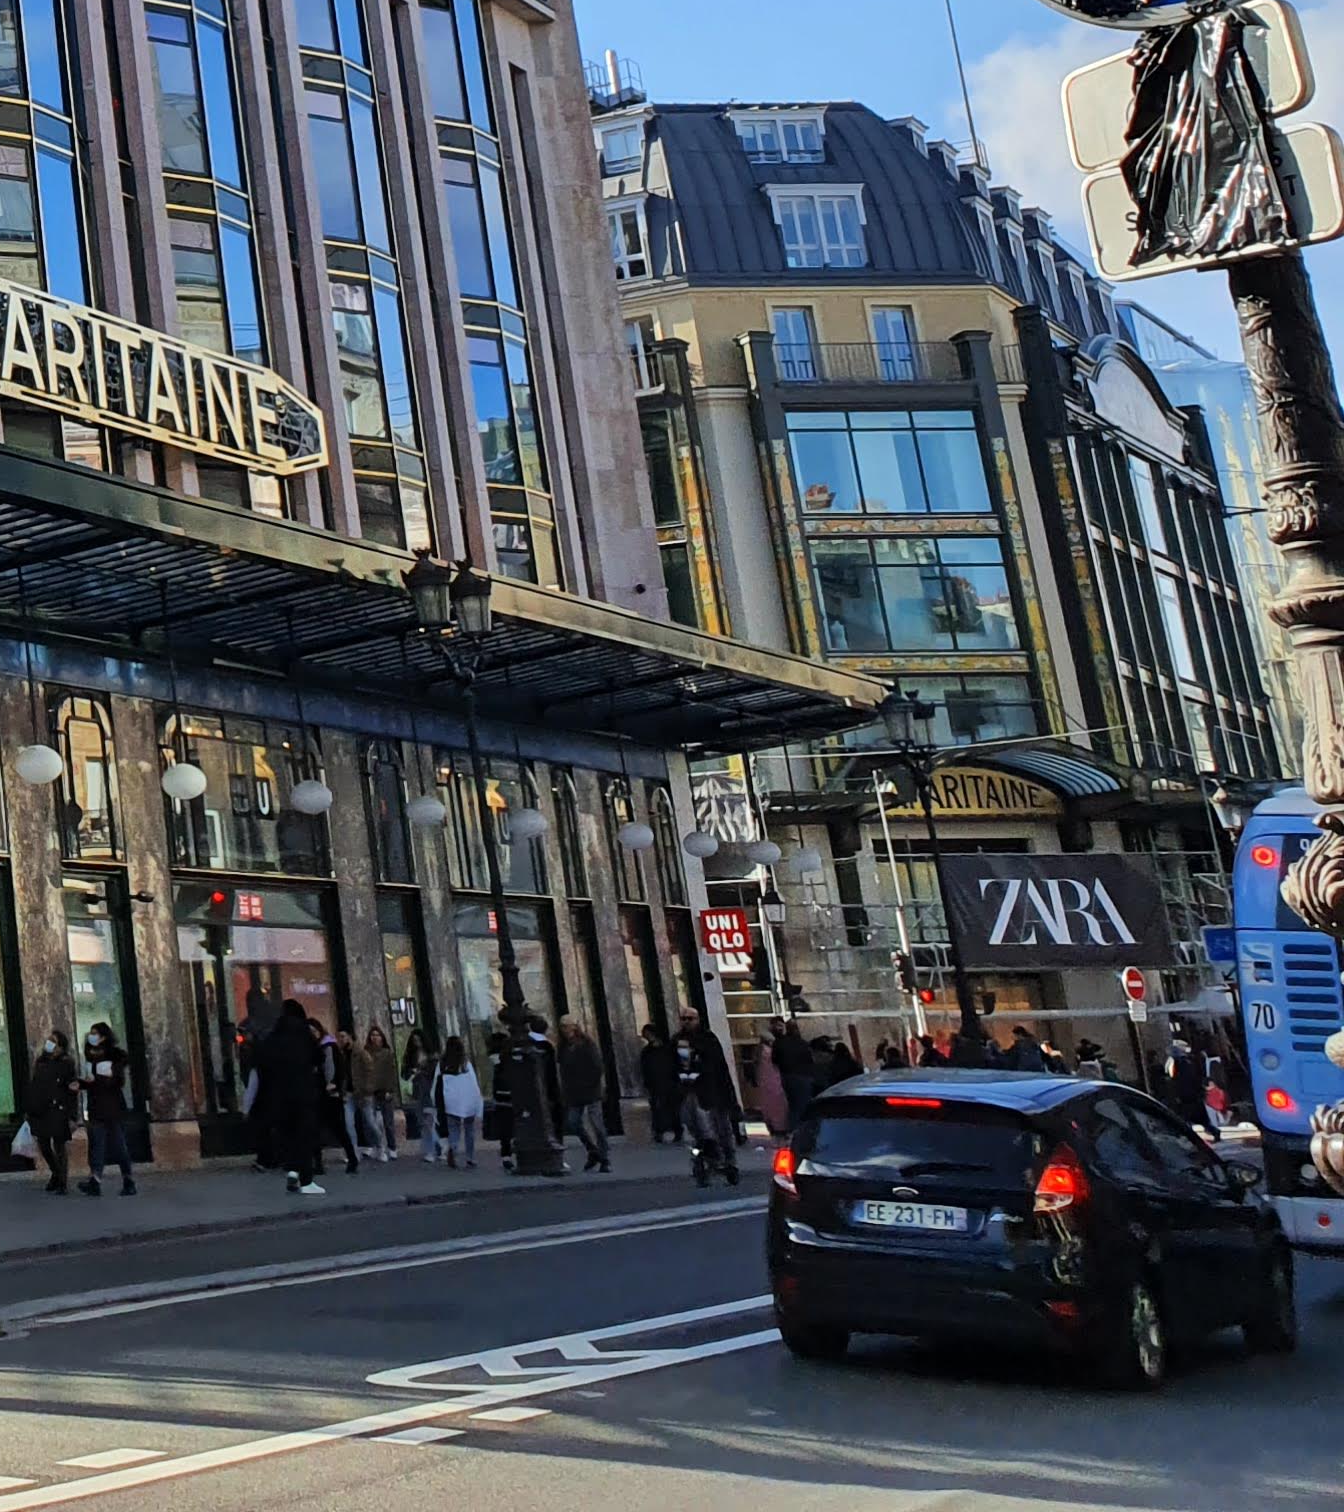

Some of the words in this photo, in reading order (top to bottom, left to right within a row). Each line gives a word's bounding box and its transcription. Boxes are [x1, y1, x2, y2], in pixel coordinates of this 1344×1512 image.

[900, 774, 1045, 810] ARITAINE
[705, 913, 739, 930] UNI
[978, 877, 1145, 946] ZARA
[709, 931, 745, 951] QLO
[1251, 1003, 1275, 1030] 70
